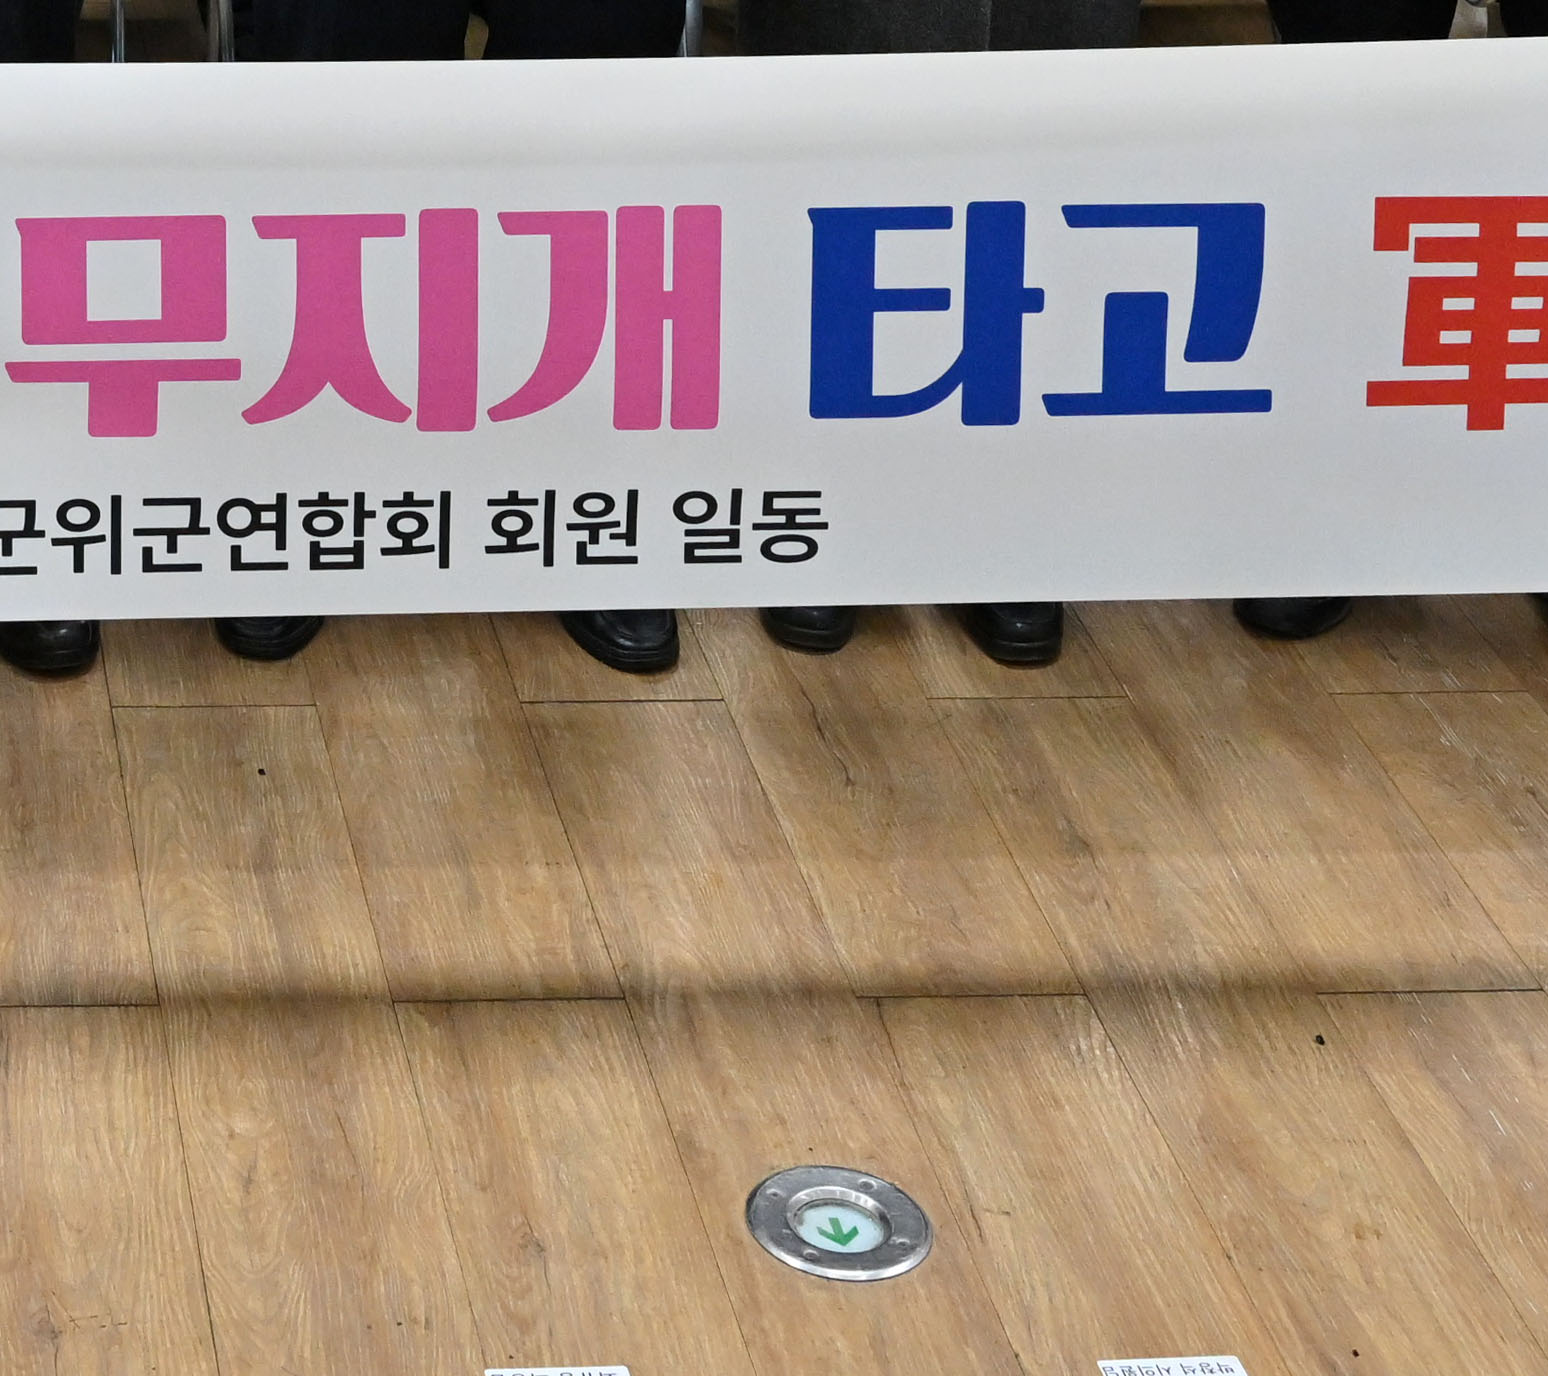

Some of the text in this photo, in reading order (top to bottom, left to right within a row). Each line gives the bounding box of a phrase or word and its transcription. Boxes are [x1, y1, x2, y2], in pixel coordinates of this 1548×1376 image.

[4, 203, 725, 441] 무지개
[807, 198, 1274, 429] 타고
[482, 487, 644, 575] 회원
[670, 485, 830, 571] 일동
